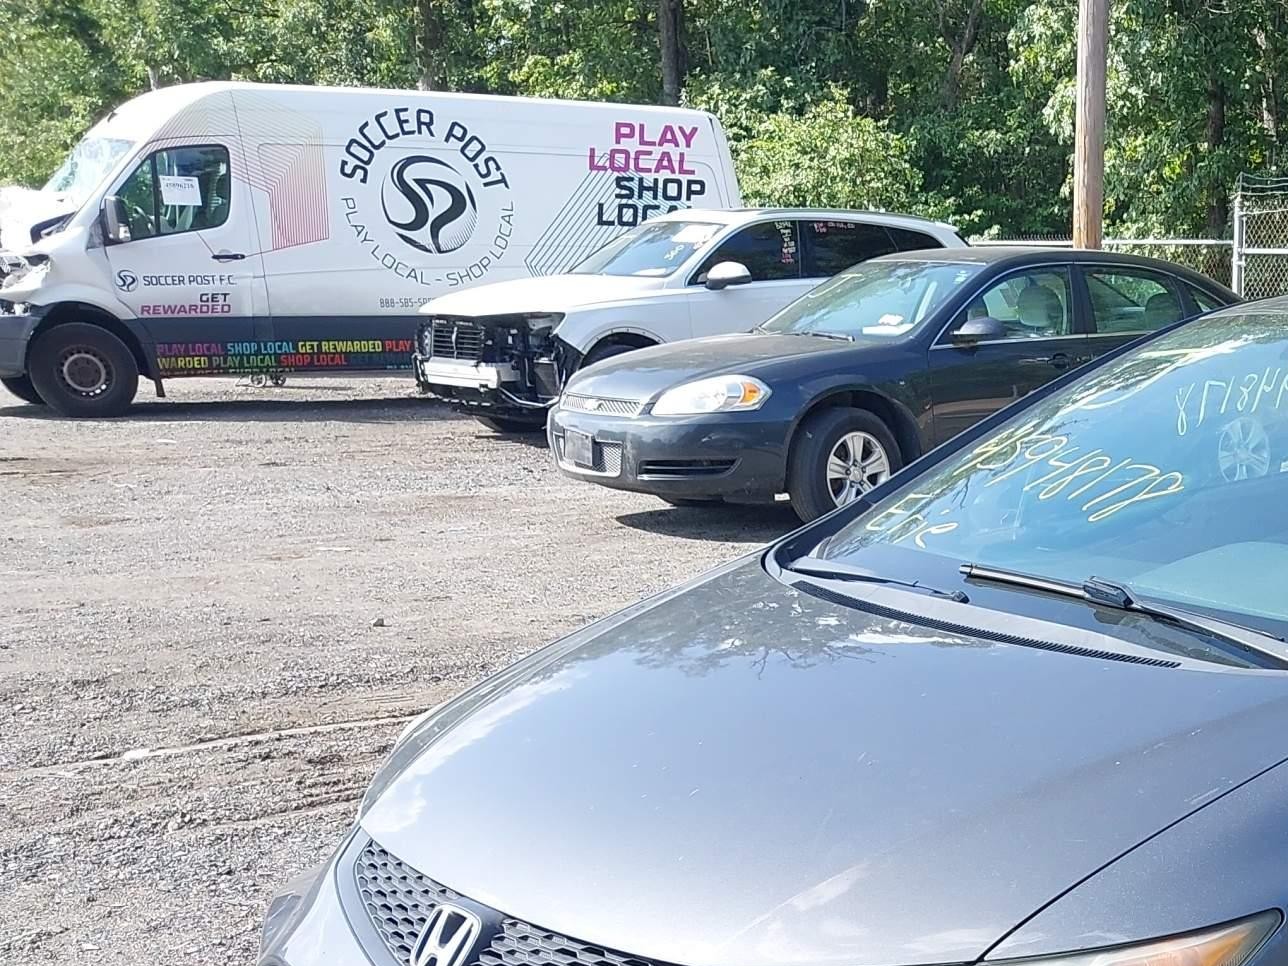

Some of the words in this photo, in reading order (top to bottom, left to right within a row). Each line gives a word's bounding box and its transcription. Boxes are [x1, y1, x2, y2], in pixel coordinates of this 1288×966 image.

[614, 121, 699, 149] PLAY
[339, 107, 436, 185] SOCCER
[444, 121, 511, 190] POST
[588, 147, 696, 176] LOCAL
[614, 176, 706, 202] SHOP
[597, 202, 693, 227] LOC
[341, 196, 375, 244] PLAY
[370, 244, 431, 286] LOCAL
[446, 256, 492, 287] SHOP
[489, 200, 515, 261] LOCAL
[143, 275, 186, 287] SOCCER
[188, 274, 217, 286] POST
[140, 303, 232, 316] REWARDED
[199, 292, 231, 303] GET
[157, 343, 185, 355] PLAY
[188, 342, 225, 355] LOCAL
[227, 342, 258, 354] SHOP
[260, 341, 296, 354] LOCAL
[298, 341, 319, 353] GET
[321, 340, 382, 353] REWARDED
[385, 340, 412, 352] PLAY
[157, 356, 209, 369] WARDED
[212, 356, 242, 368] PLAY
[243, 355, 278, 367] LOCAL
[280, 354, 311, 366] SHOP
[314, 353, 348, 366] LOCAL
